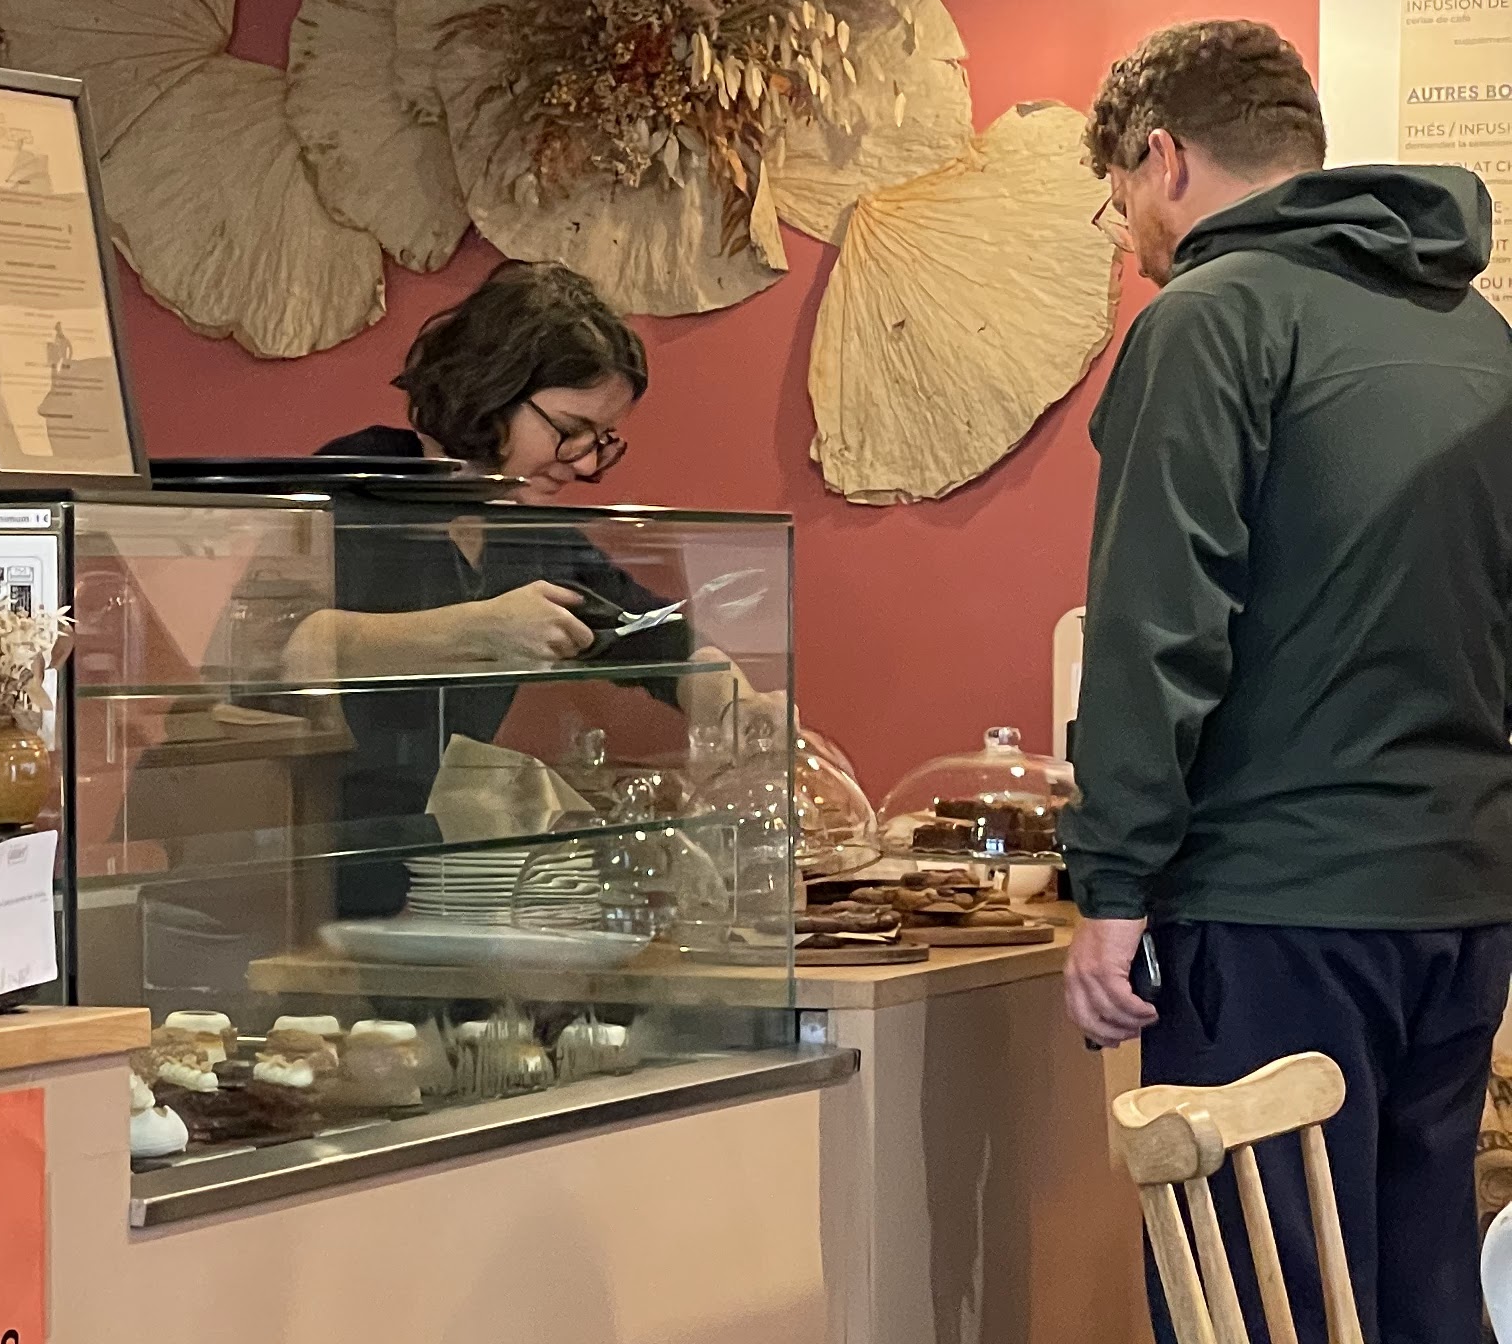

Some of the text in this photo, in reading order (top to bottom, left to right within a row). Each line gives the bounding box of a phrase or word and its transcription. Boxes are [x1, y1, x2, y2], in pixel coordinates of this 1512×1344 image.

[1407, 85, 1479, 102] AUTRES
[1405, 121, 1445, 138] THÉS
[1480, 276, 1503, 290] DU
